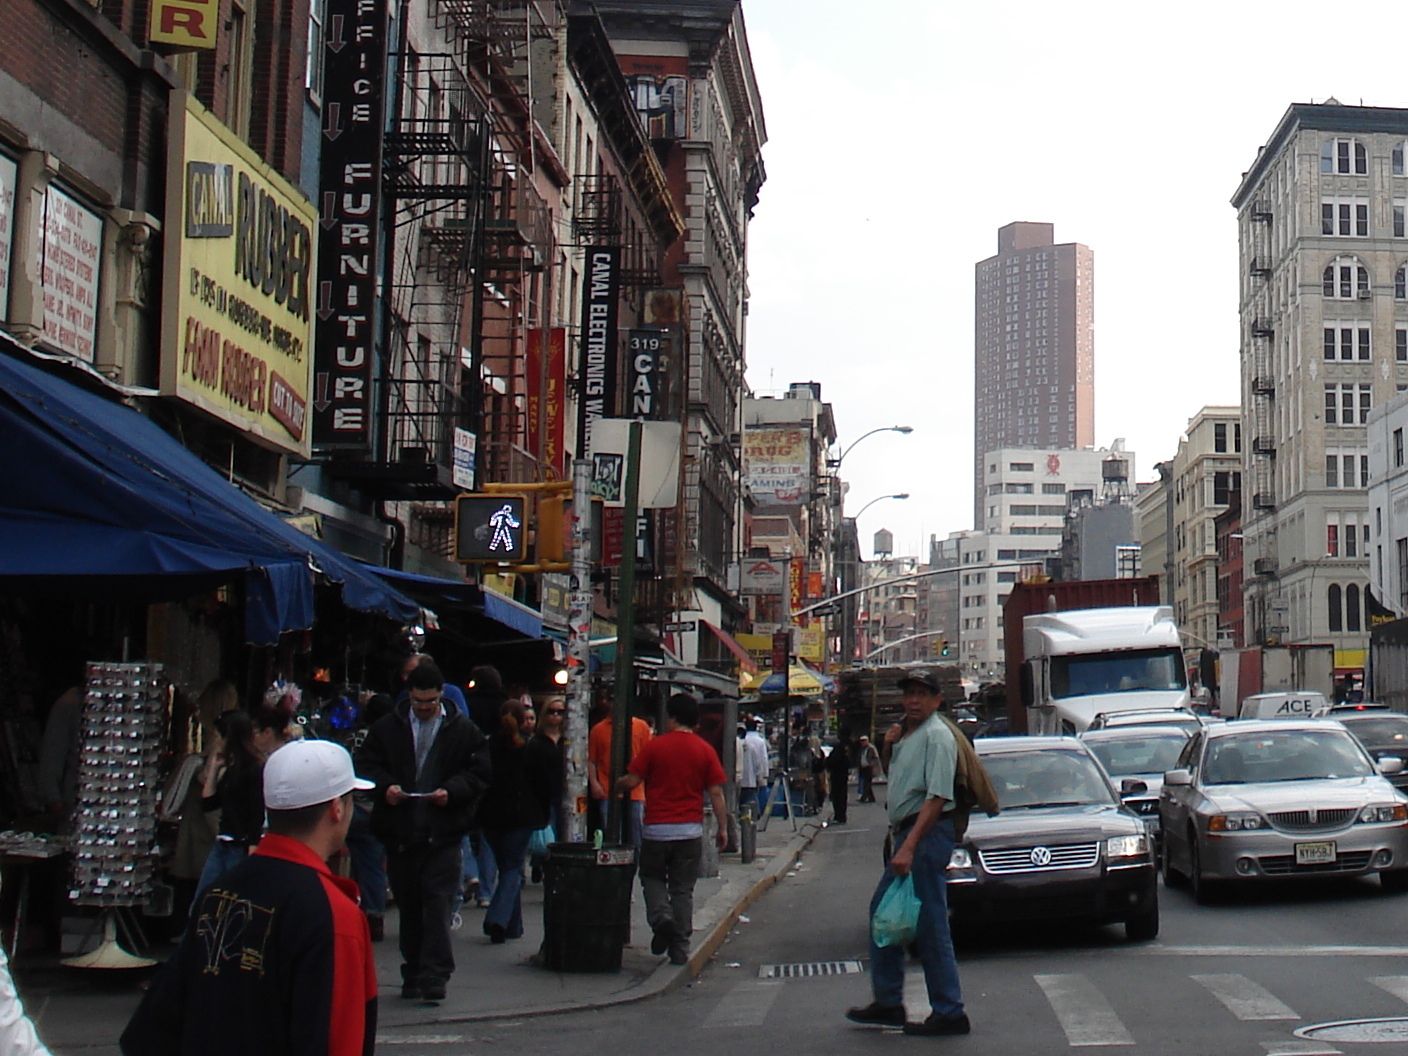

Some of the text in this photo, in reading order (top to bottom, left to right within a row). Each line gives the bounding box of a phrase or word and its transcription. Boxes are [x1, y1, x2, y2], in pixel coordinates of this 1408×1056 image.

[192, 170, 310, 323] CANAL RUBBER
[590, 252, 612, 299] CANAL
[333, 162, 372, 430] FURNITURE
[221, 339, 267, 416] RUBBER
[584, 302, 608, 398] ELECTRONICS
[631, 337, 659, 350] 319
[633, 354, 653, 421] CAN
[1277, 699, 1312, 714] ACE
